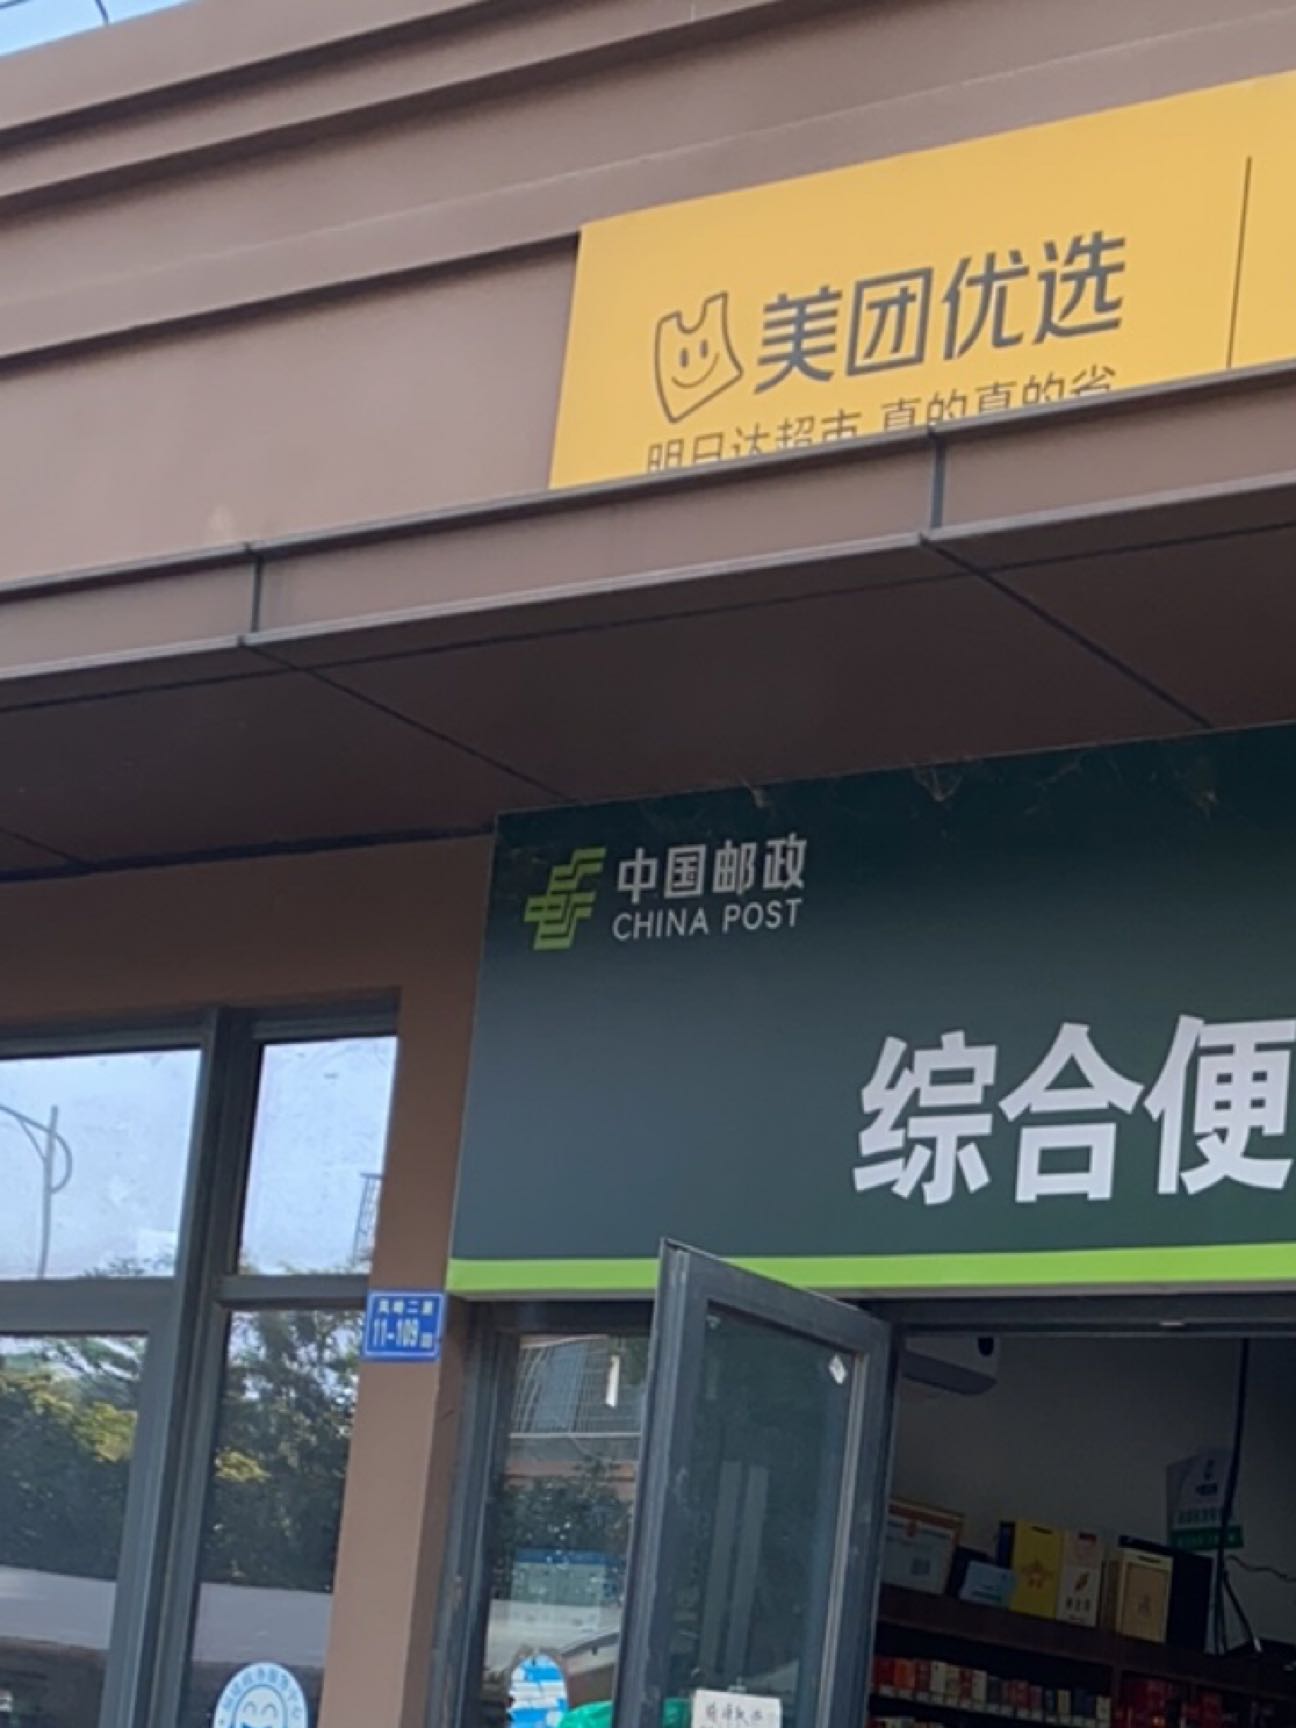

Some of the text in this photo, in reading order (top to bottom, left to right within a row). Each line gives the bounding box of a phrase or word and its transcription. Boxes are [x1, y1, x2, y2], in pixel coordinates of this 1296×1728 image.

[754, 229, 1127, 395] 美团优选
[616, 832, 808, 905] 中国邮政
[611, 898, 802, 942] CHINA POST
